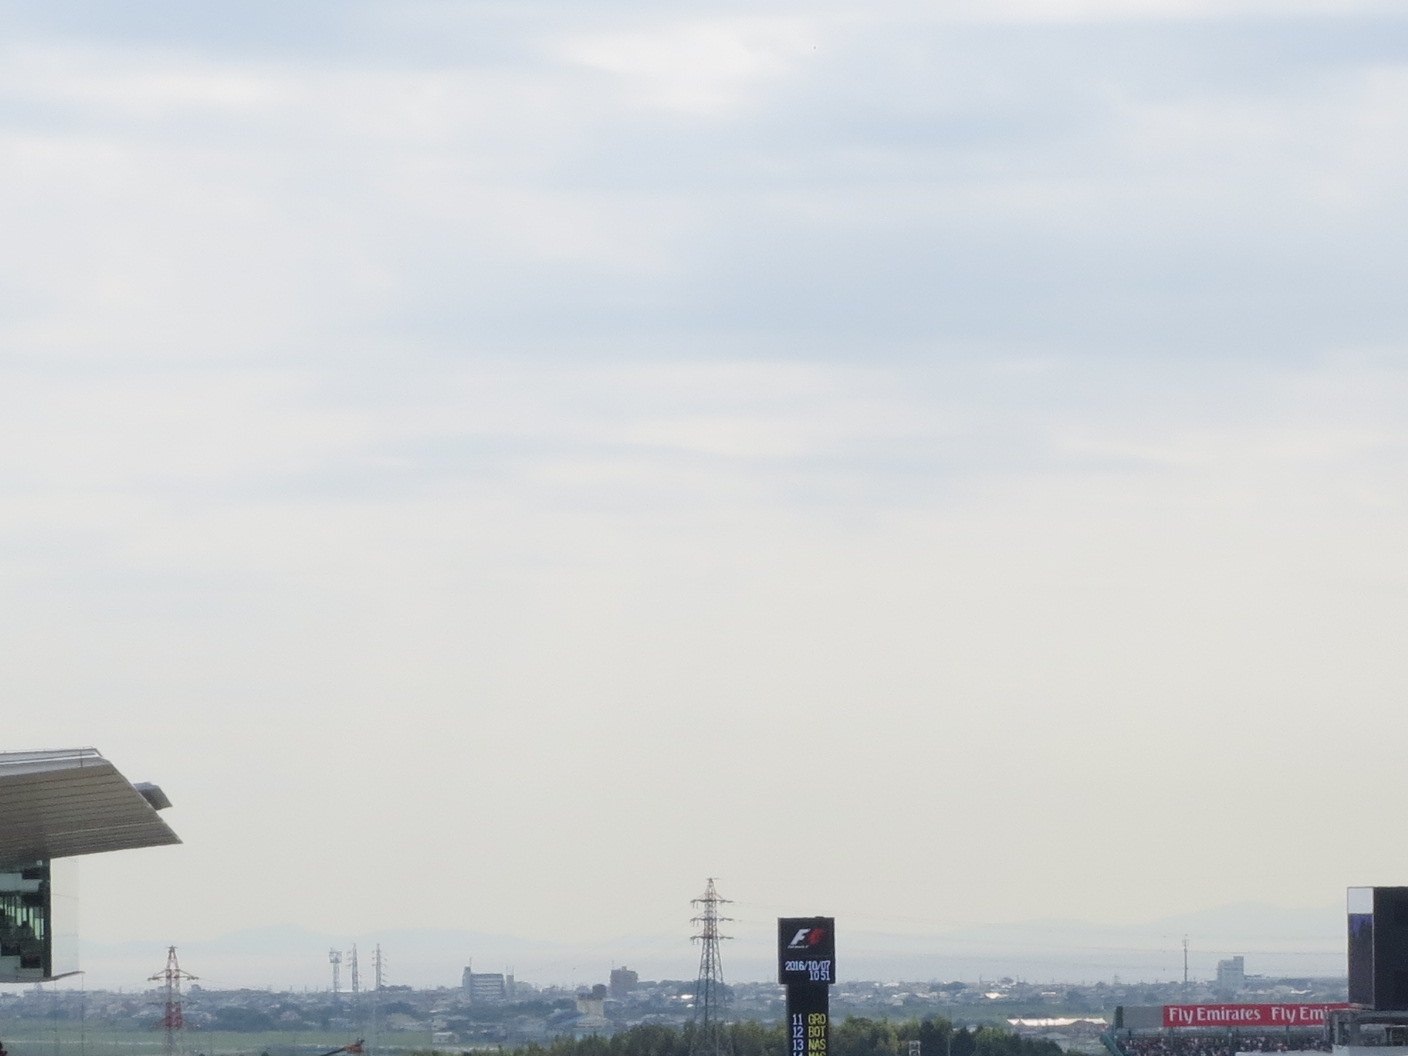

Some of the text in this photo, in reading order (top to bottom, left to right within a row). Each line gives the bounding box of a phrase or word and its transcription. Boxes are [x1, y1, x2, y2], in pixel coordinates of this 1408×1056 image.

[785, 960, 831, 971] 2016/10/07
[793, 1013, 826, 1025] 11 GRO
[1169, 1006, 1261, 1024] Fly Emirates
[1271, 1006, 1296, 1023] Fly
[793, 1026, 826, 1038] 12 BOT
[793, 1038, 826, 1051] 13 NAS
